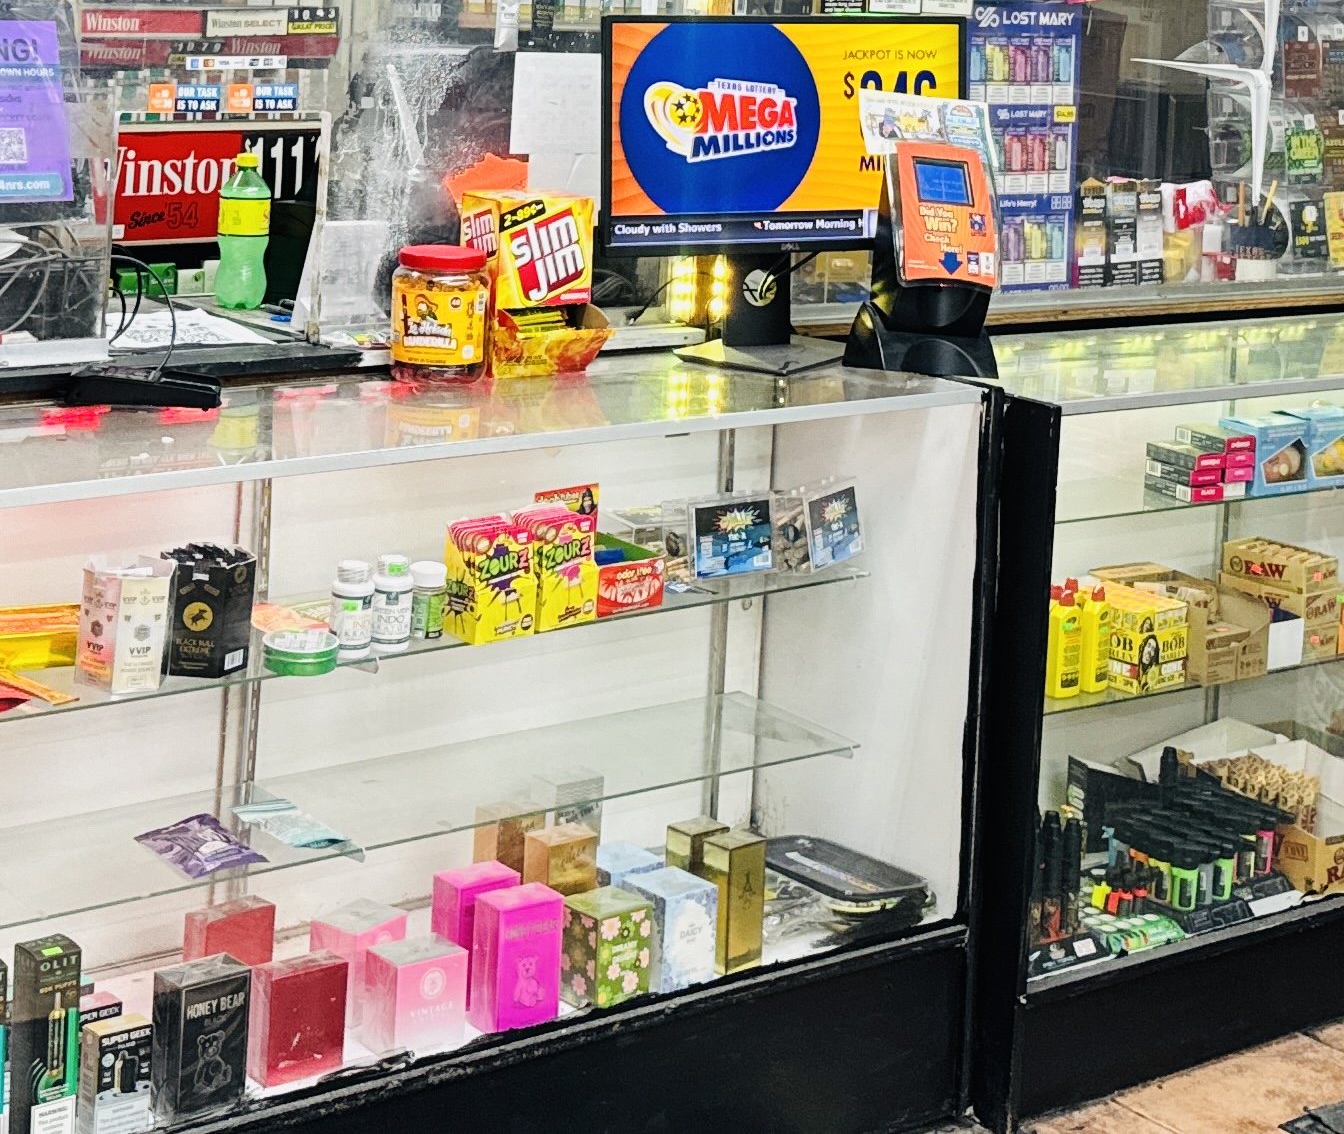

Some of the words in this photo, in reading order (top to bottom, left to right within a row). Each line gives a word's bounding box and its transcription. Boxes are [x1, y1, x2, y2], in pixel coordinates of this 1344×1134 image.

[86, 12, 139, 32] Winston
[244, 19, 282, 28] SELECT
[1003, 12, 1035, 25] LOST
[1039, 13, 1074, 26] MARY
[843, 50, 890, 60] JACKPOT
[907, 50, 937, 59] NOW
[0, 68, 21, 76] OWN
[24, 68, 54, 77] HOURS
[717, 81, 741, 90] TEXAS
[745, 84, 777, 94] LOTTERY
[698, 92, 794, 133] MEGA
[692, 130, 794, 157] MILLIONS
[920, 207, 935, 216] Did
[128, 210, 165, 229] Since
[614, 223, 649, 235] Cloudy
[652, 223, 676, 234] with
[679, 222, 722, 234] Showers
[763, 220, 813, 231] Tomorrow
[816, 219, 856, 231] Morning
[924, 217, 958, 232] Win?
[924, 235, 949, 244] Check
[479, 548, 530, 577] ZOURZ
[186, 999, 218, 1018] HONEY
[220, 993, 246, 1011] BEAR
